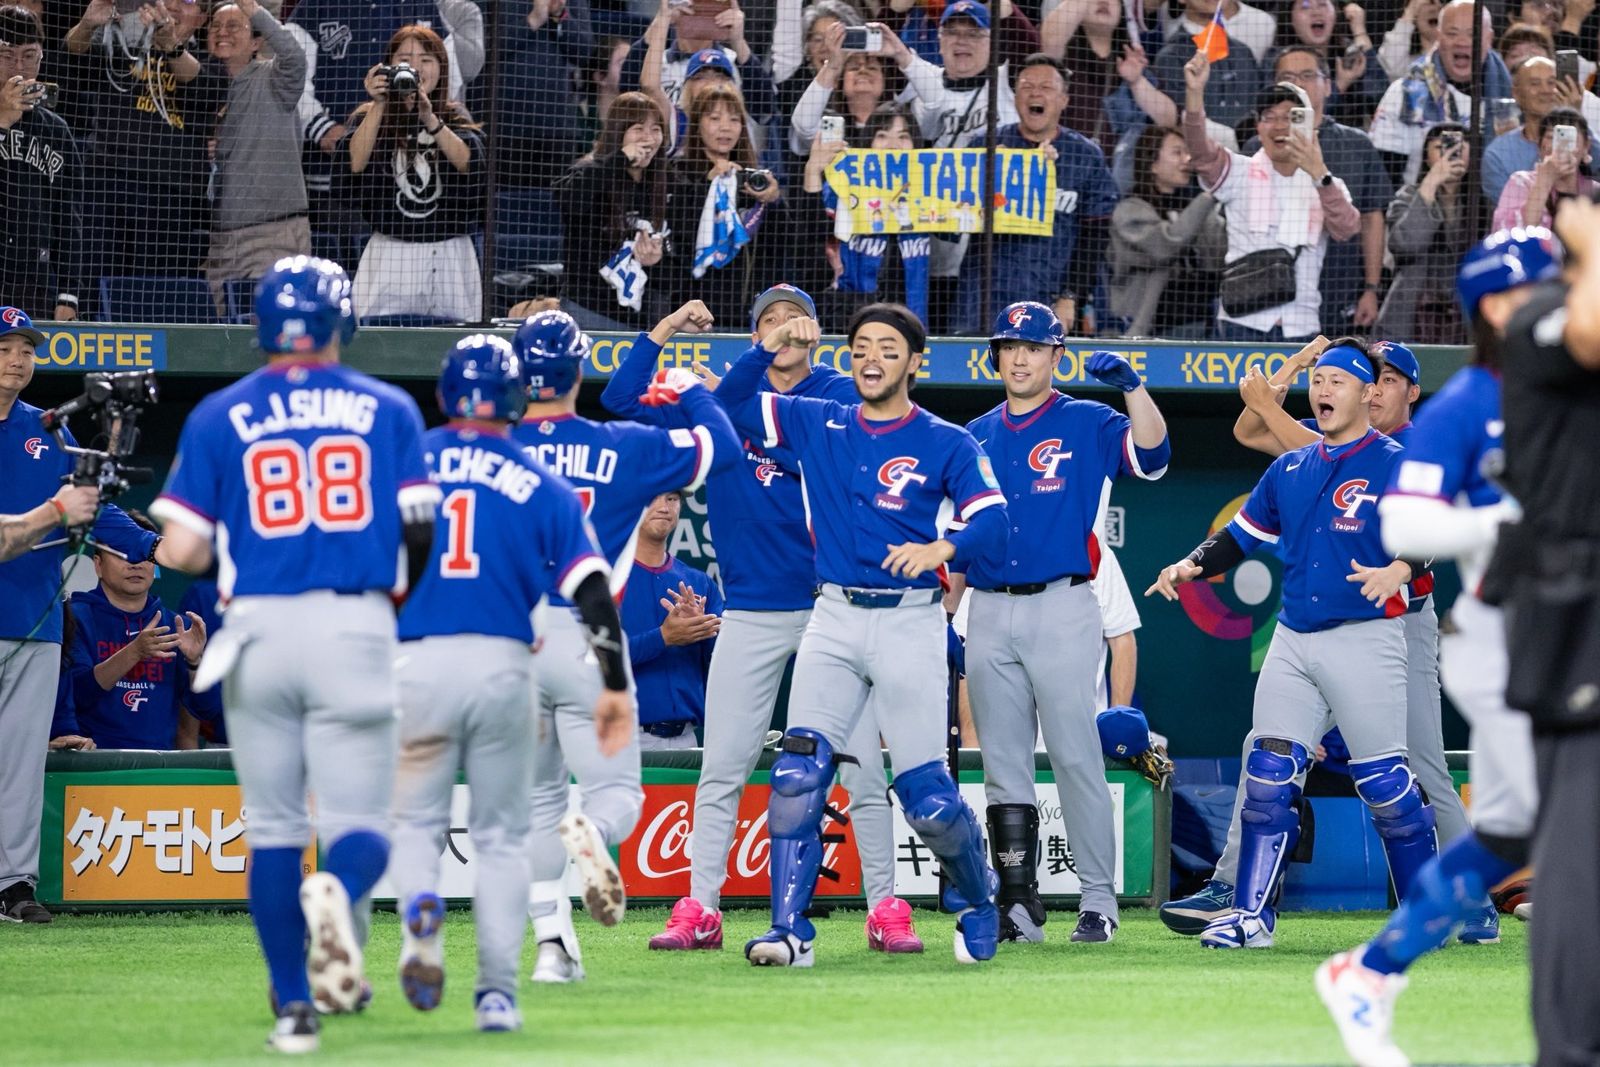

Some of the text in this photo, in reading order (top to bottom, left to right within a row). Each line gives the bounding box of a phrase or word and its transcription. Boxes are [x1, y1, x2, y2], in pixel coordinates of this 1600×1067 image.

[242, 435, 374, 540] 88
[1036, 483, 1060, 492] Taipei
[440, 489, 480, 579] 1
[1334, 522, 1359, 532] Taipei
